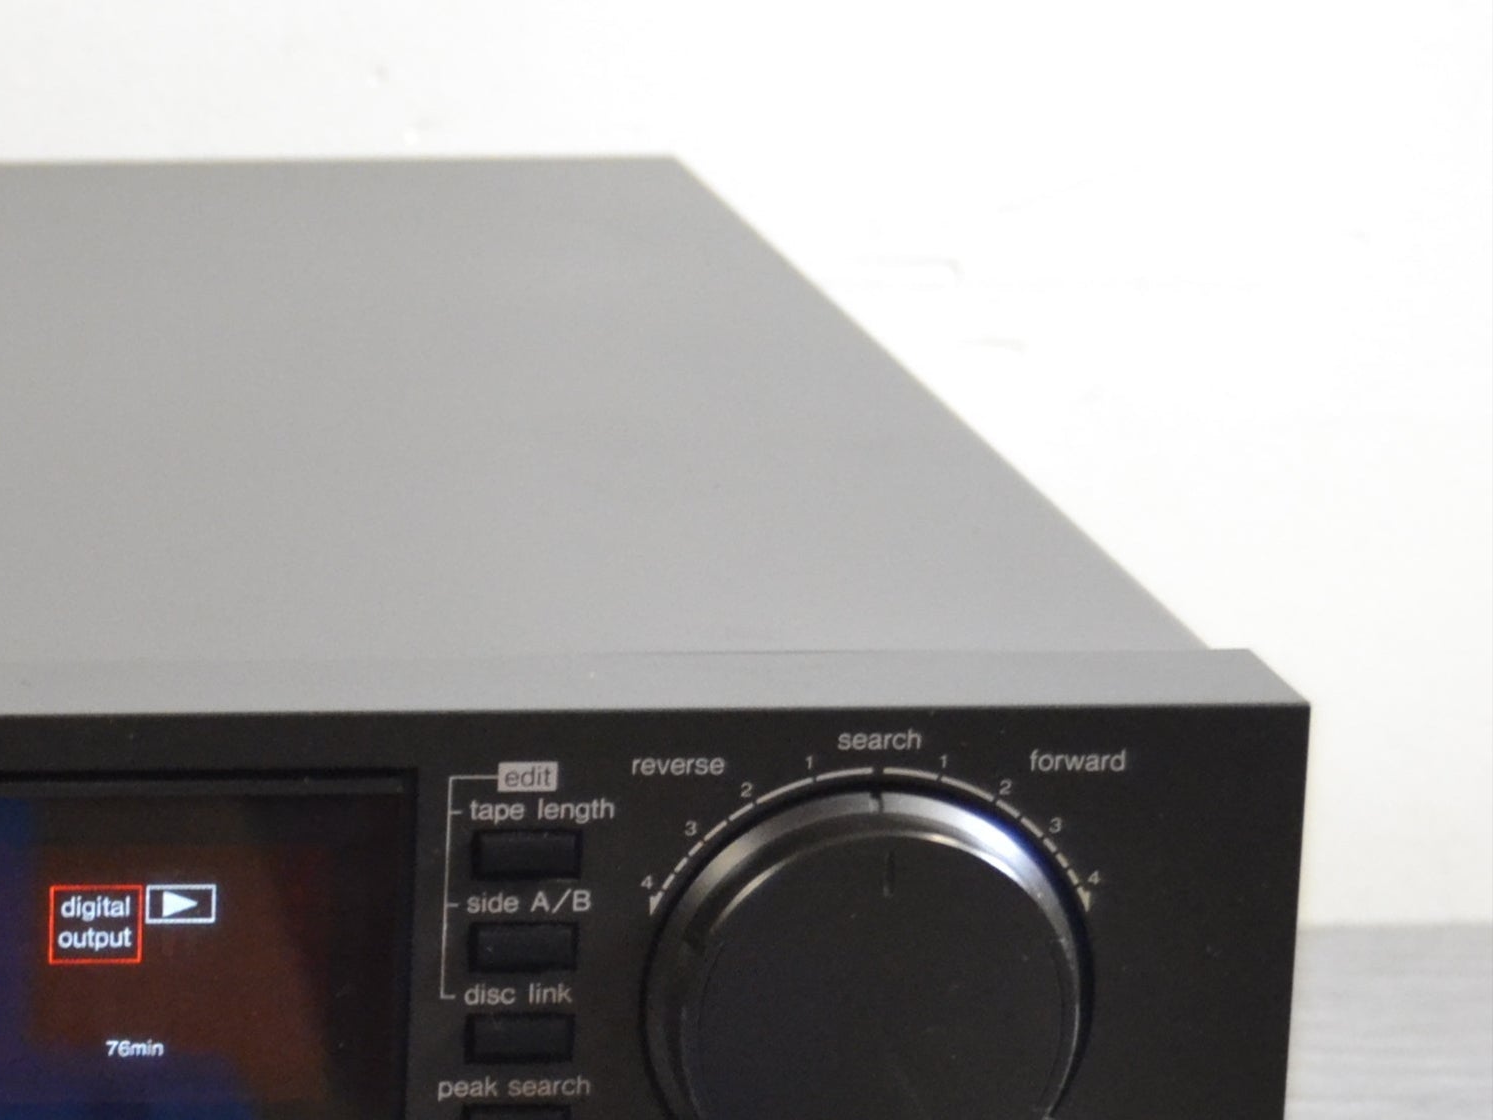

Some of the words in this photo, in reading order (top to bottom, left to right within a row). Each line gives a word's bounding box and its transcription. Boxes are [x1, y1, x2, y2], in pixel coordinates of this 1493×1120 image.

[836, 728, 922, 752] search
[630, 752, 727, 777] reverse
[805, 755, 814, 770] 1
[939, 754, 949, 769] 1
[1029, 750, 1127, 773] forward
[503, 764, 553, 790] edit
[999, 780, 1012, 795] 2
[740, 783, 753, 798] 2
[470, 800, 525, 824] tape
[537, 798, 616, 824] length
[685, 820, 698, 836] 3
[1049, 817, 1063, 834] 3
[640, 875, 654, 890] 4
[1087, 870, 1102, 884] 4
[60, 895, 131, 922] digital
[466, 890, 519, 914] side
[530, 890, 593, 914] A/B
[58, 926, 132, 950] output
[464, 984, 515, 1005] disc
[528, 983, 572, 1003] link
[106, 1040, 164, 1057] 76min
[437, 1077, 498, 1101] peak
[507, 1076, 590, 1097] search
